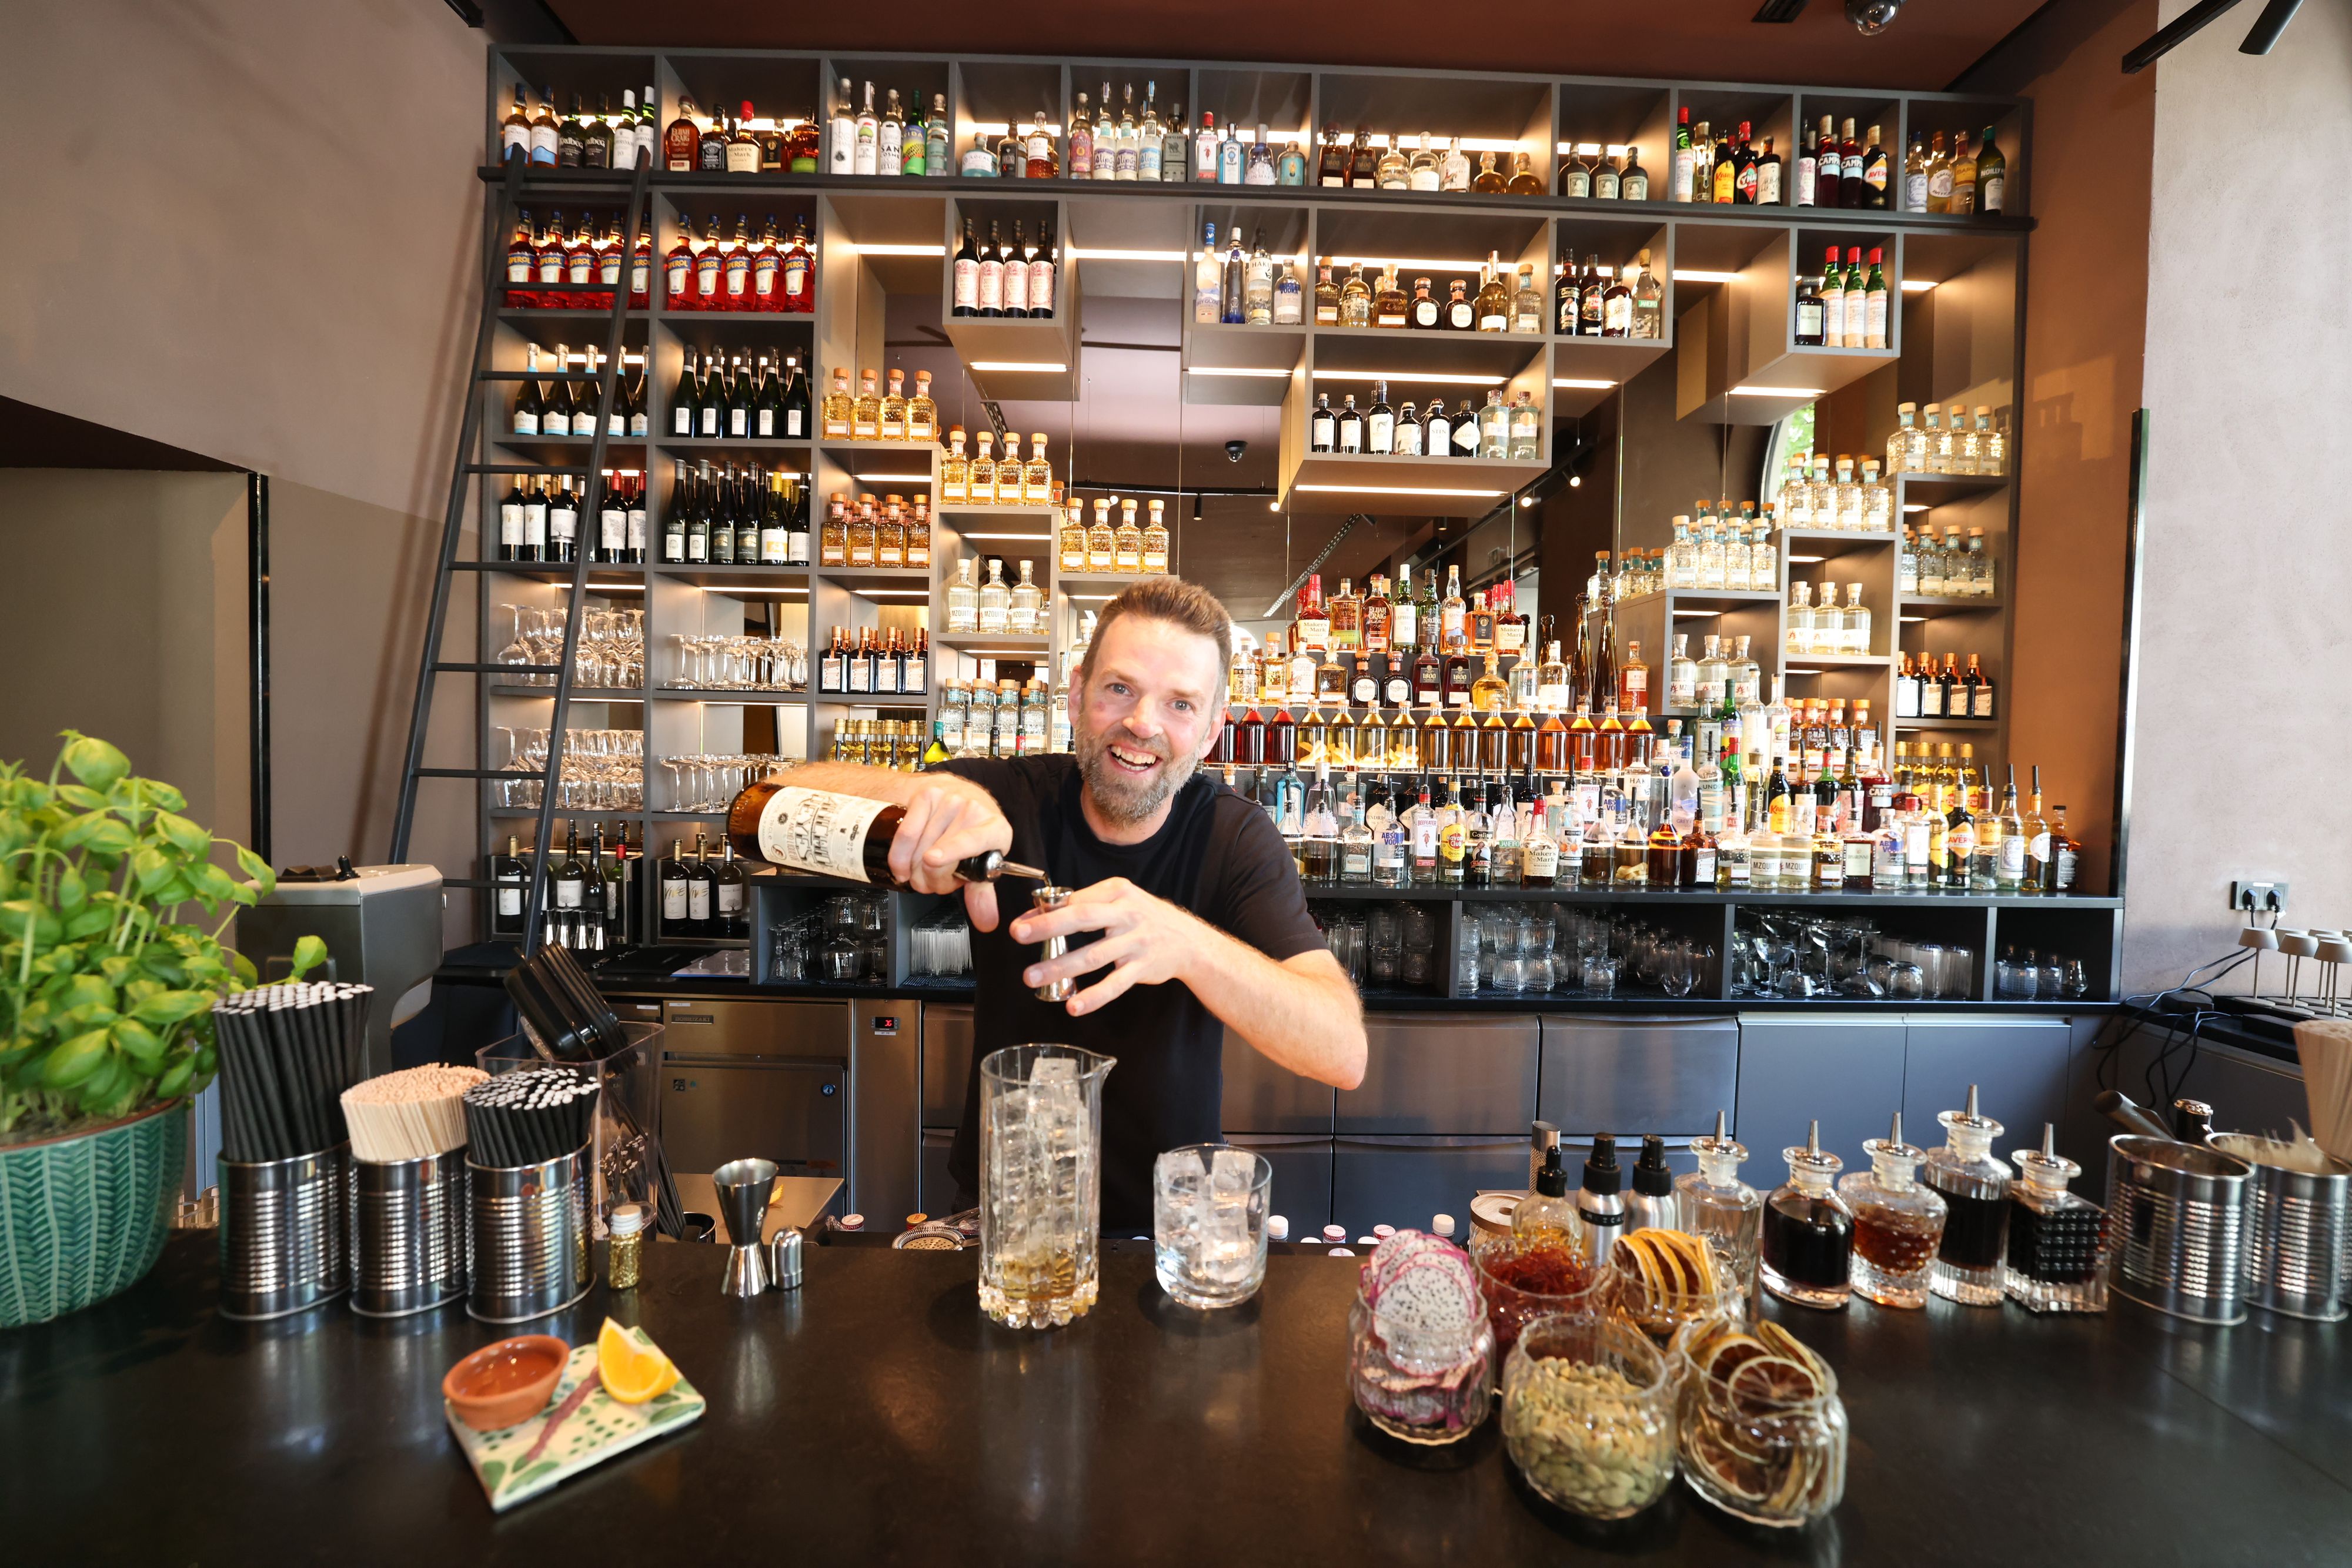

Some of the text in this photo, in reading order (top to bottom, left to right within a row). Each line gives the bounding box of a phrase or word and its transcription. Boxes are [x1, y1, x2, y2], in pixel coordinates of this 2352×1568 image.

[1818, 156, 1840, 166] CAMP
[1841, 159, 1863, 169] CAMP
[1869, 787, 1892, 795] CAMP
[1472, 831, 1494, 839] Goslin
[1753, 861, 1776, 870] MZQUIT
[1785, 862, 1808, 870] MZQUIT
[664, 886, 687, 900] VIVE
